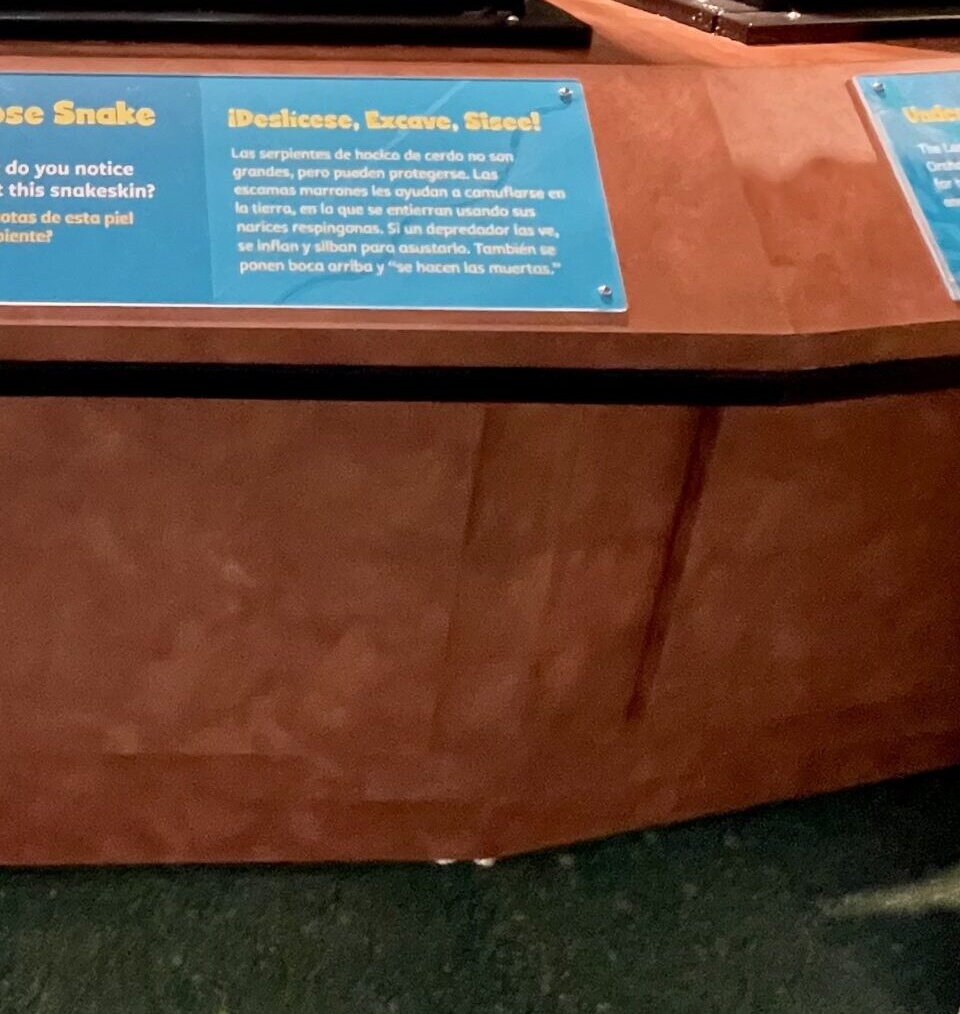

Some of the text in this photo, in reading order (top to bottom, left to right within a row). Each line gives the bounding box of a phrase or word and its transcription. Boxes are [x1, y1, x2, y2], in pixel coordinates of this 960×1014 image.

[53, 99, 155, 126] Snake
[364, 109, 459, 132] Excave,
[231, 148, 514, 163] Las serpientes de hocico de cerdo no son
[5, 160, 29, 175] do
[34, 164, 69, 179] you
[75, 161, 134, 176] notice
[233, 166, 498, 183] grandes, pero pueden protegerse. Las
[8, 181, 45, 197] this
[50, 182, 155, 198] snakeskin?
[234, 185, 566, 201] escamas marrones les ayudan a camuflarse en
[235, 202, 536, 218] la tierra, en la que se entierran usando sus
[40, 210, 62, 224] de
[64, 212, 101, 225] esta
[103, 211, 134, 228] piel
[237, 220, 559, 238] narices respingonas. Si un depredador las ve,
[238, 239, 556, 256] se inflan y silban para asustarlo. También se
[240, 261, 285, 274] ponen
[288, 259, 325, 272] boca
[327, 259, 373, 273] arriba
[376, 263, 385, 276] y
[416, 261, 461, 274] hacen
[463, 262, 486, 274] las
